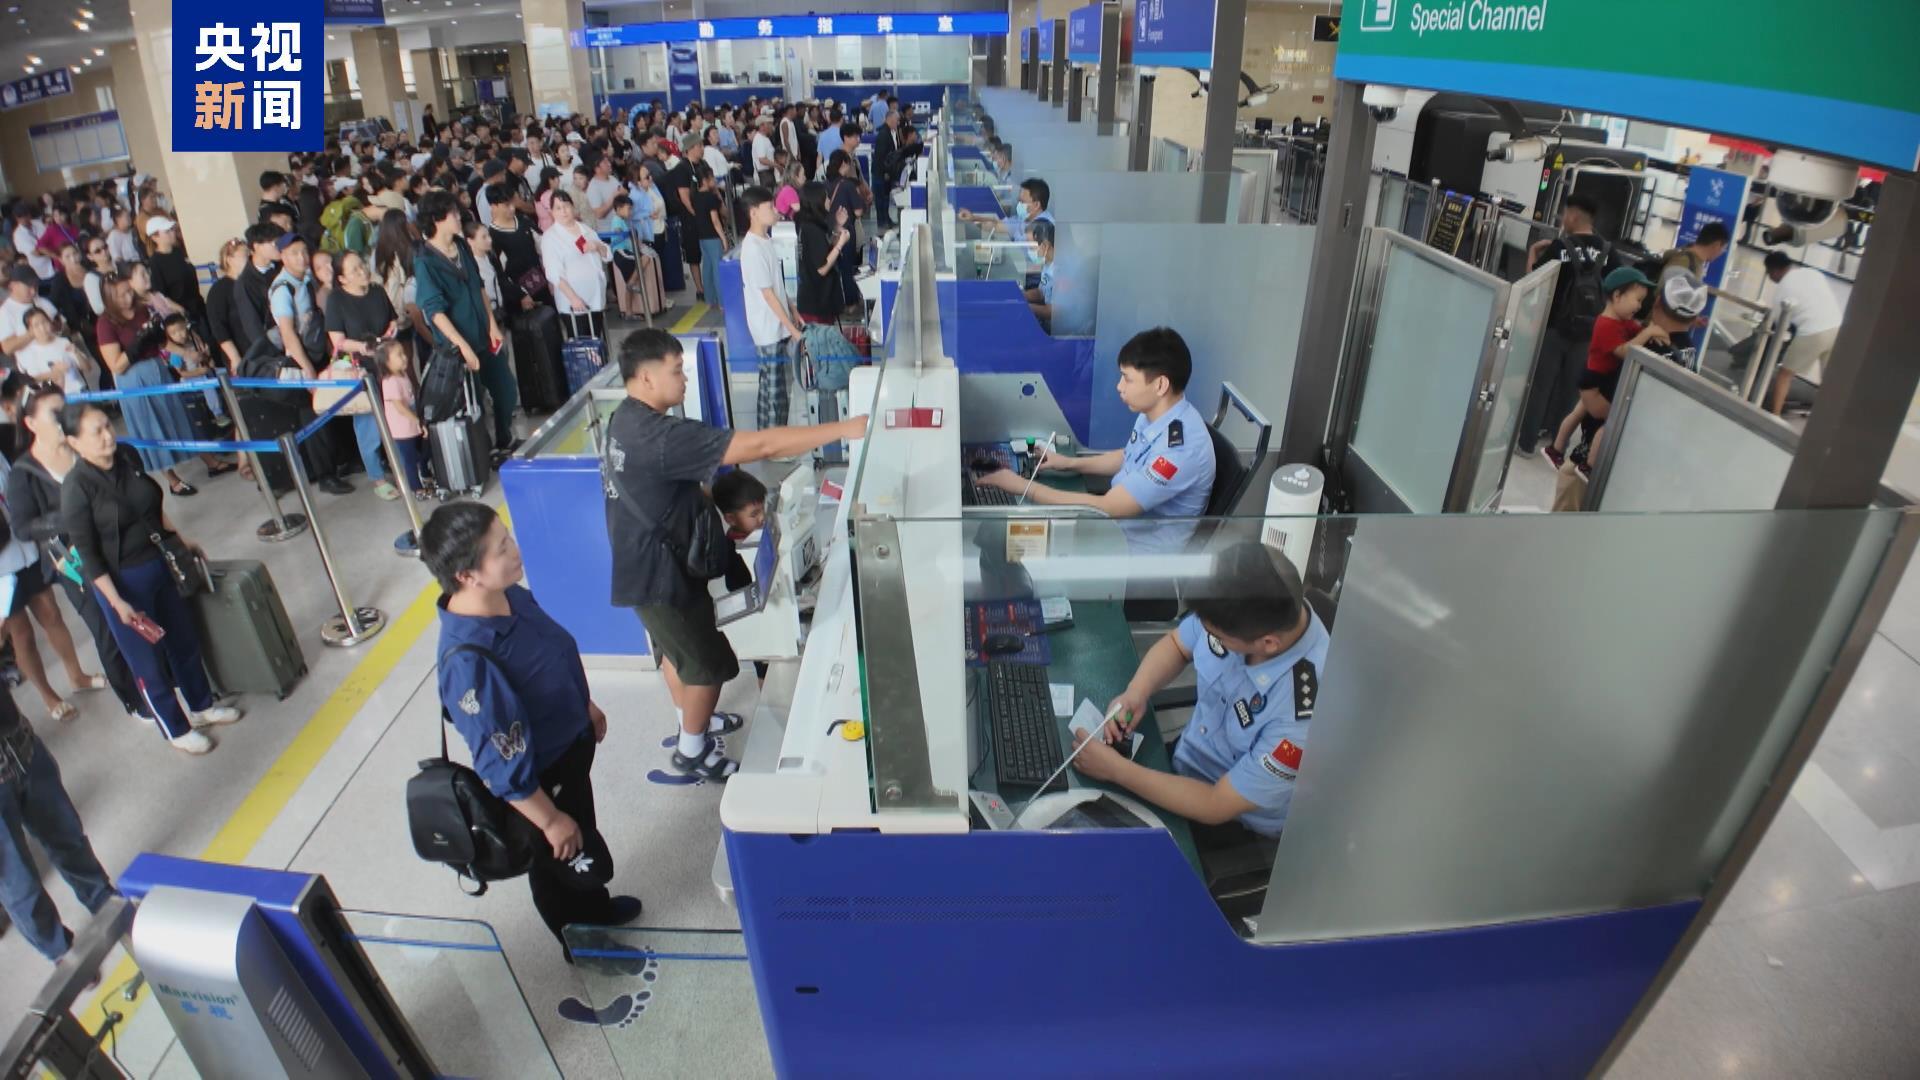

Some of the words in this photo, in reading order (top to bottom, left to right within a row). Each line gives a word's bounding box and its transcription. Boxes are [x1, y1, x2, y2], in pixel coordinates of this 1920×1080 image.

[1410, 0, 1466, 38] Special
[1468, 0, 1547, 31] Channel
[158, 983, 236, 1006] Maxvision
